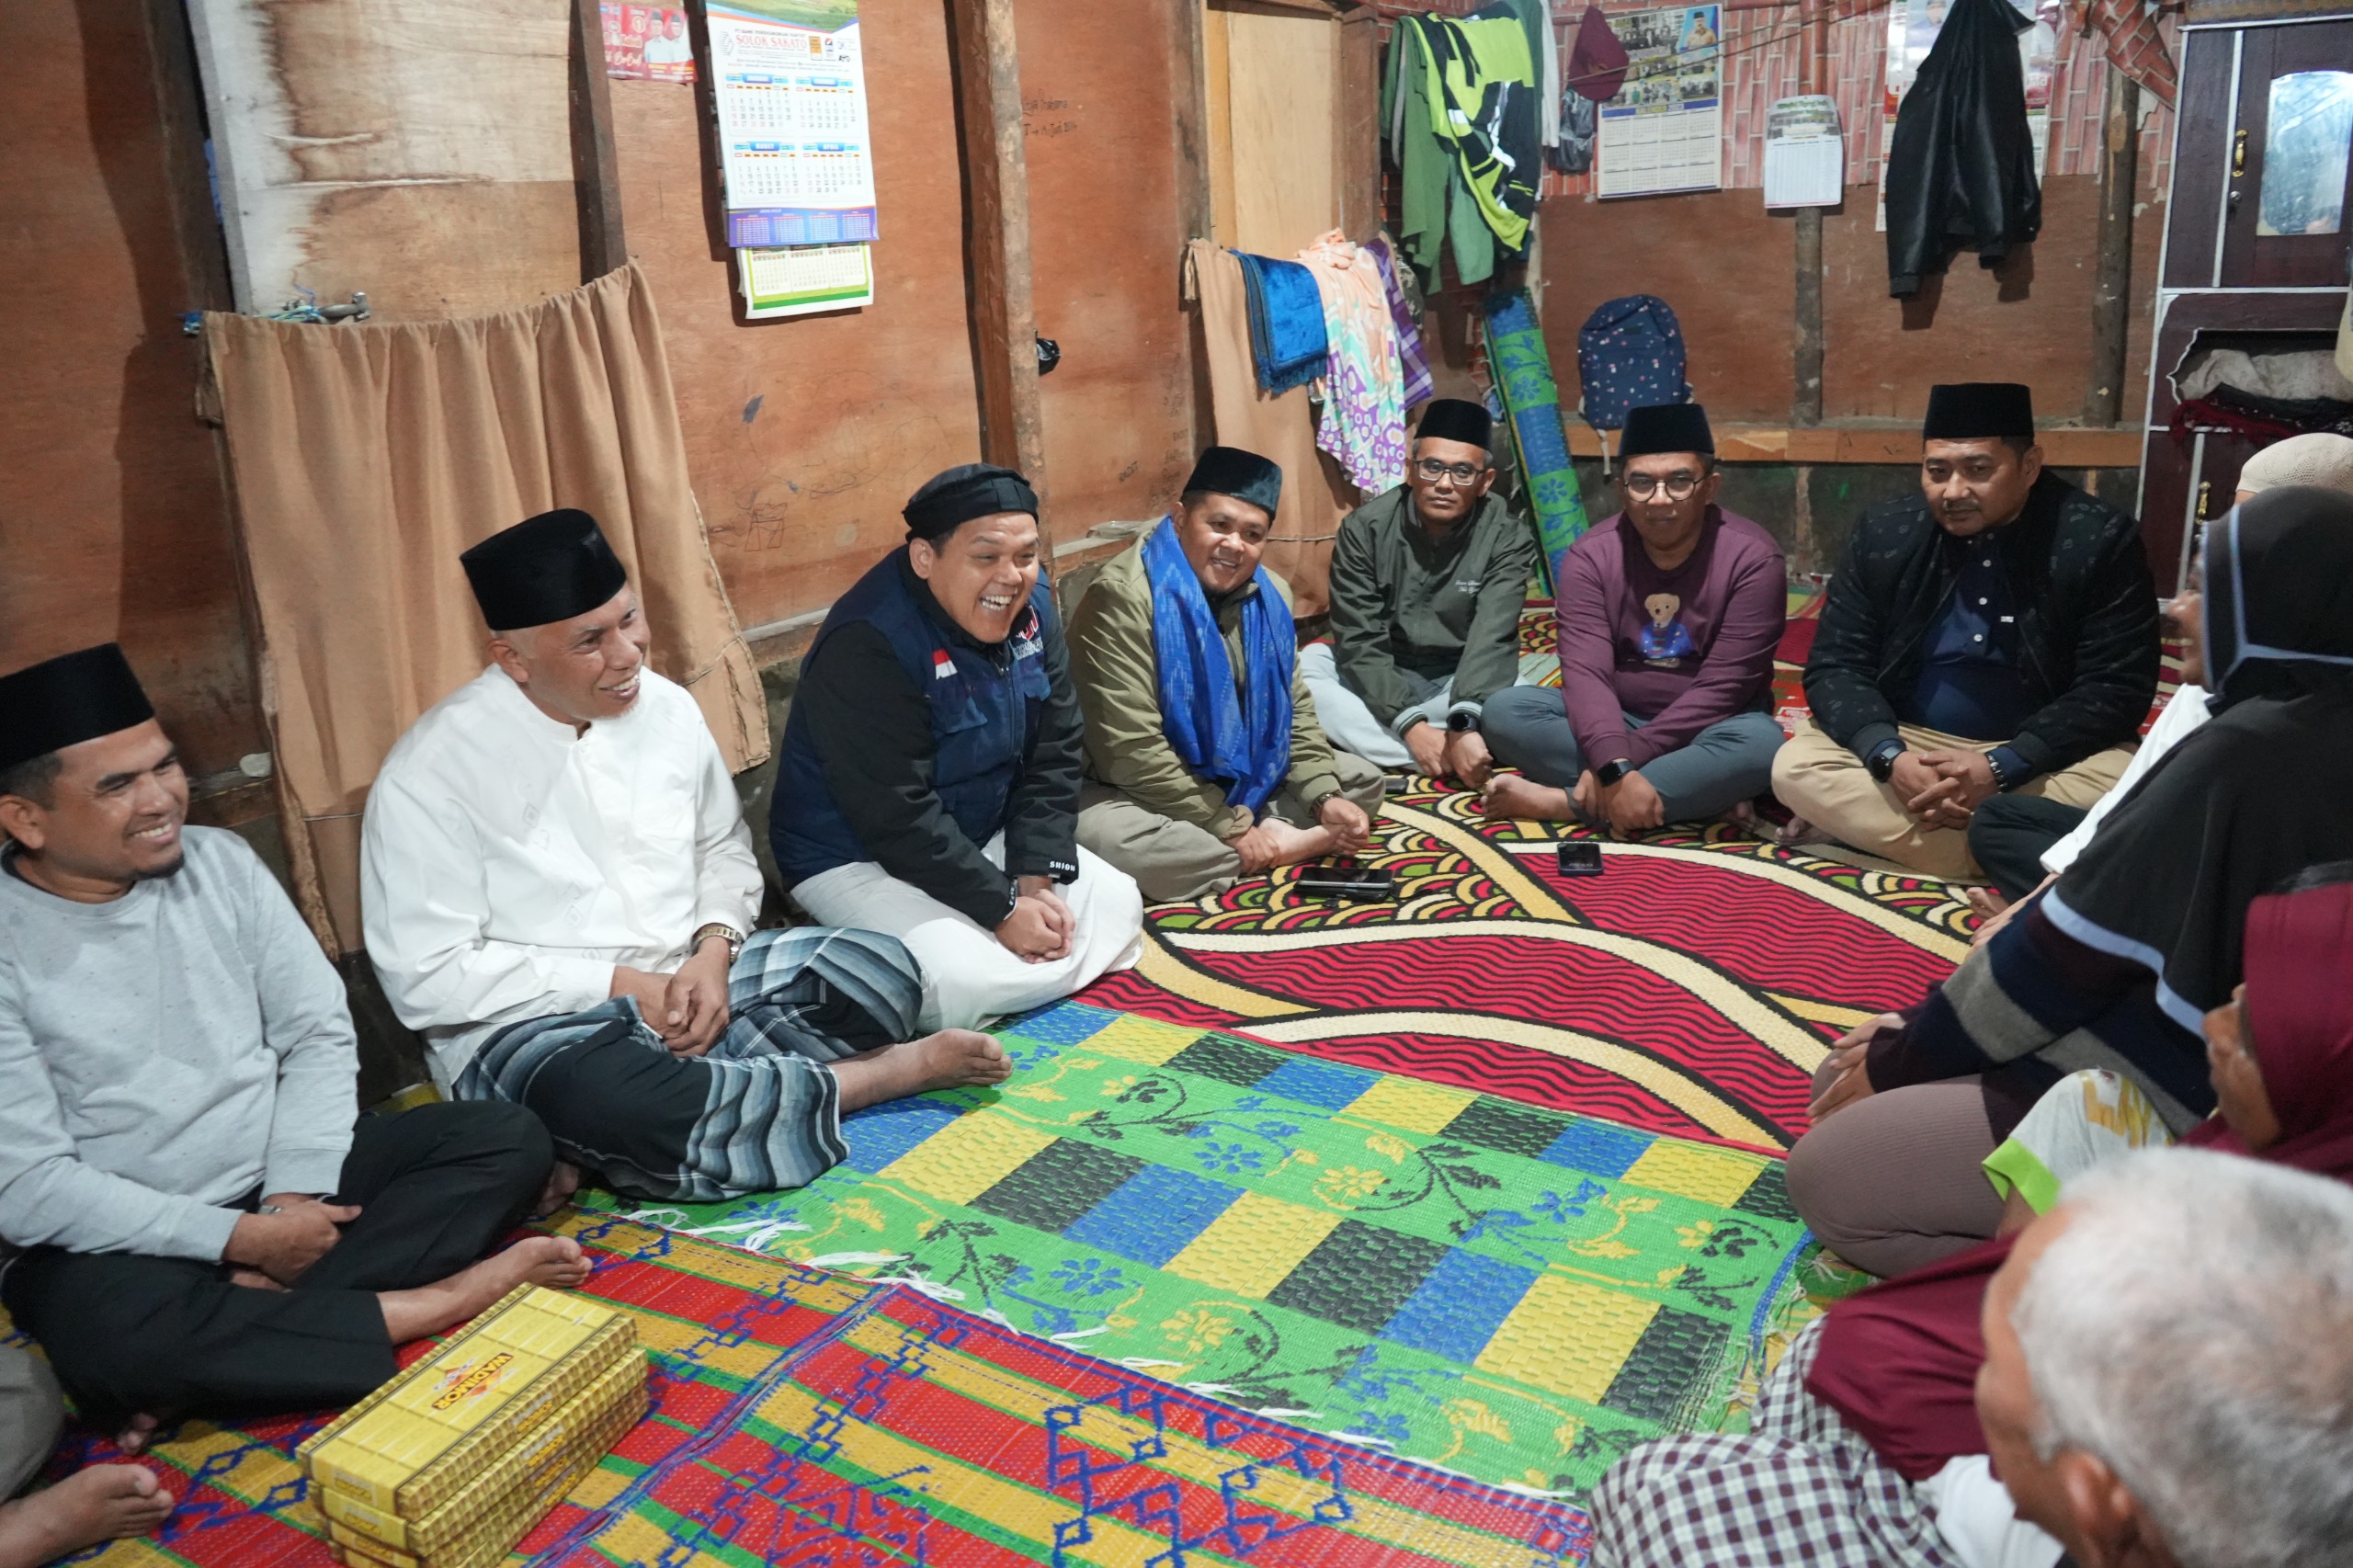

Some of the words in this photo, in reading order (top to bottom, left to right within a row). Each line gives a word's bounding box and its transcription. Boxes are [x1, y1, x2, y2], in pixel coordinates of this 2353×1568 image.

[735, 34, 768, 46] SOLOK
[770, 37, 807, 49] SAKATO
[432, 1354, 514, 1410] WADIMOR
